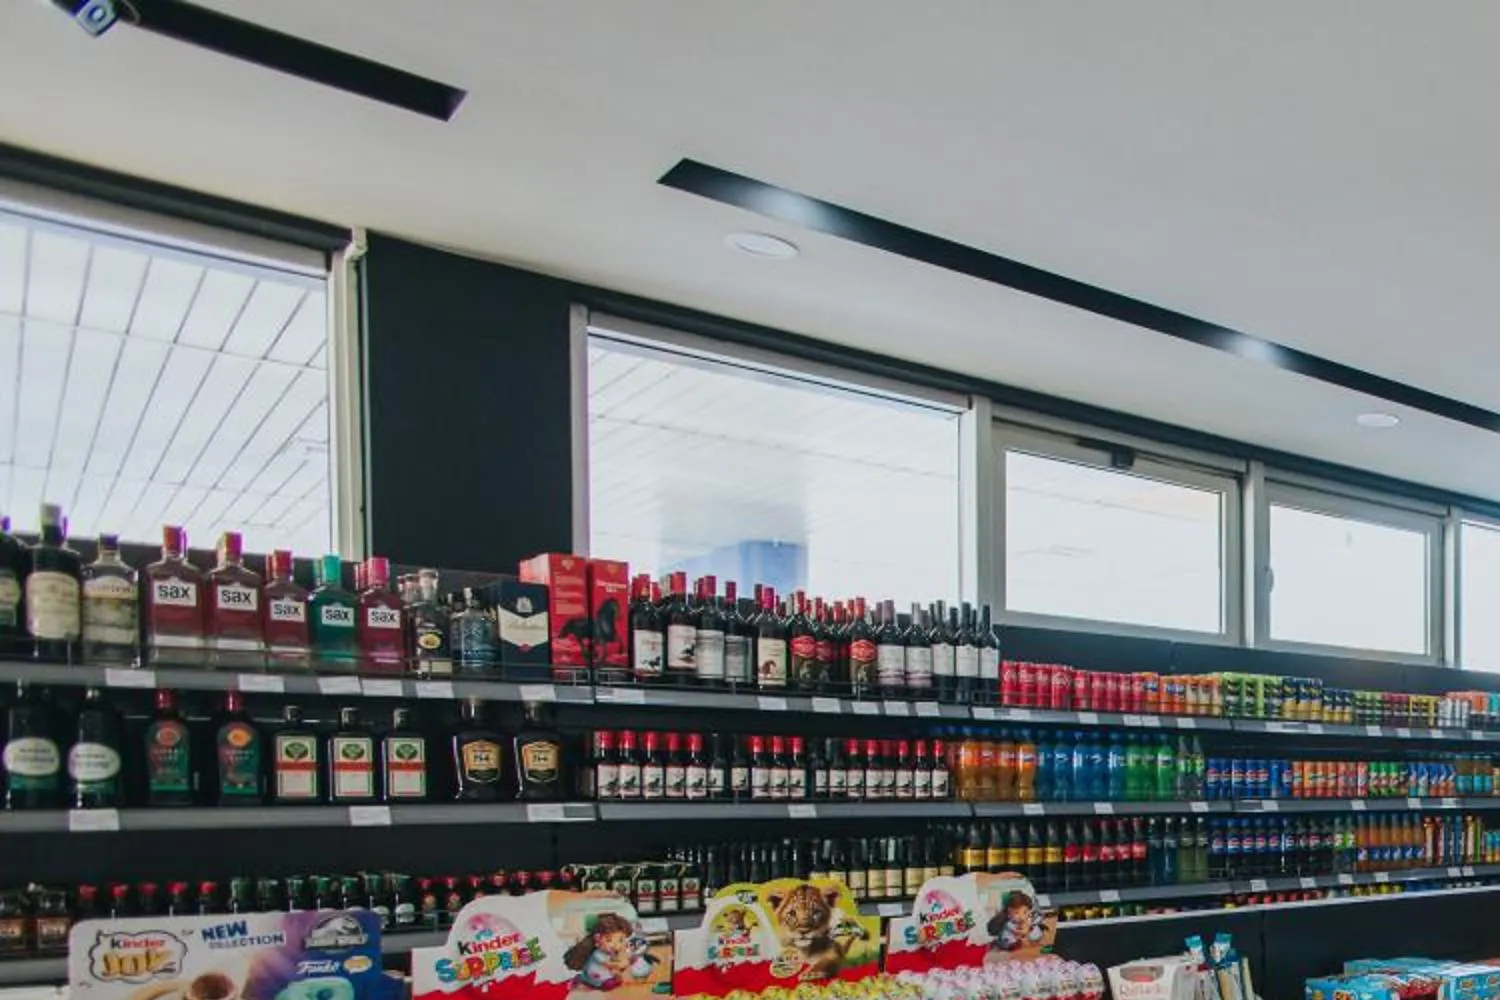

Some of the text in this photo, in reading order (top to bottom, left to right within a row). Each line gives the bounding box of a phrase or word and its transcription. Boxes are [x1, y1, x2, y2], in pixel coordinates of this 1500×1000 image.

[158, 584, 192, 599] sax
[221, 588, 253, 603] sax
[273, 602, 301, 617] sax
[325, 608, 350, 621] sax
[371, 610, 397, 623] sax
[202, 920, 249, 941] NEW
[457, 932, 521, 955] Kinder
